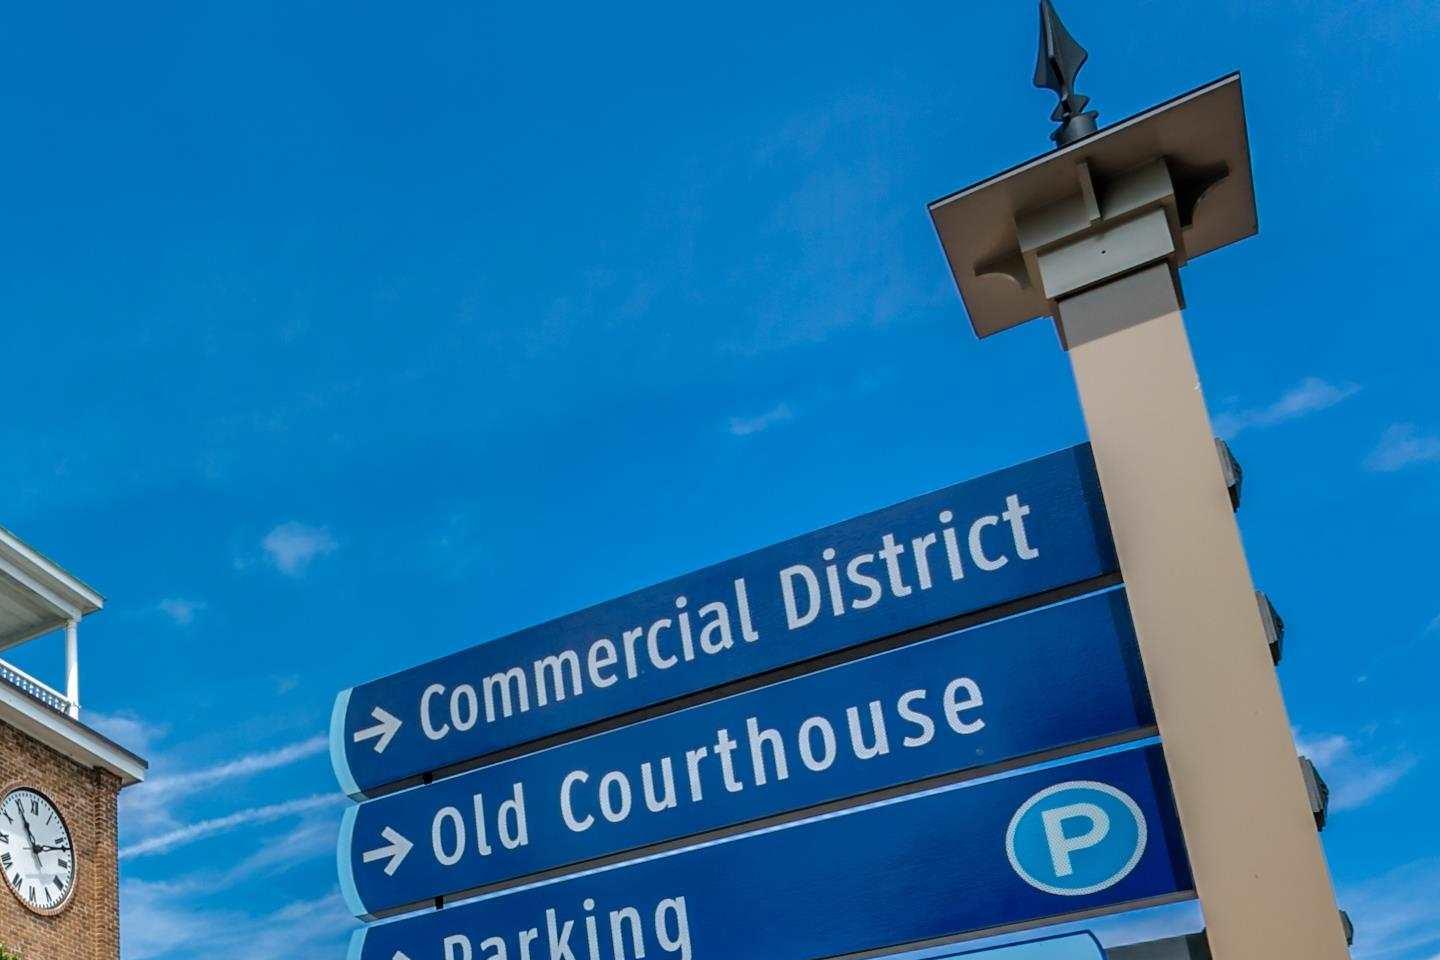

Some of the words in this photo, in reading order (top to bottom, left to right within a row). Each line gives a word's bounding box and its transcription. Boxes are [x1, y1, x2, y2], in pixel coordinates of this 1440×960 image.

[418, 578, 759, 742] Commercial
[782, 495, 1040, 632] District
[430, 783, 529, 869] Old
[560, 673, 987, 832] Courthouse
[1040, 801, 1112, 878] P
